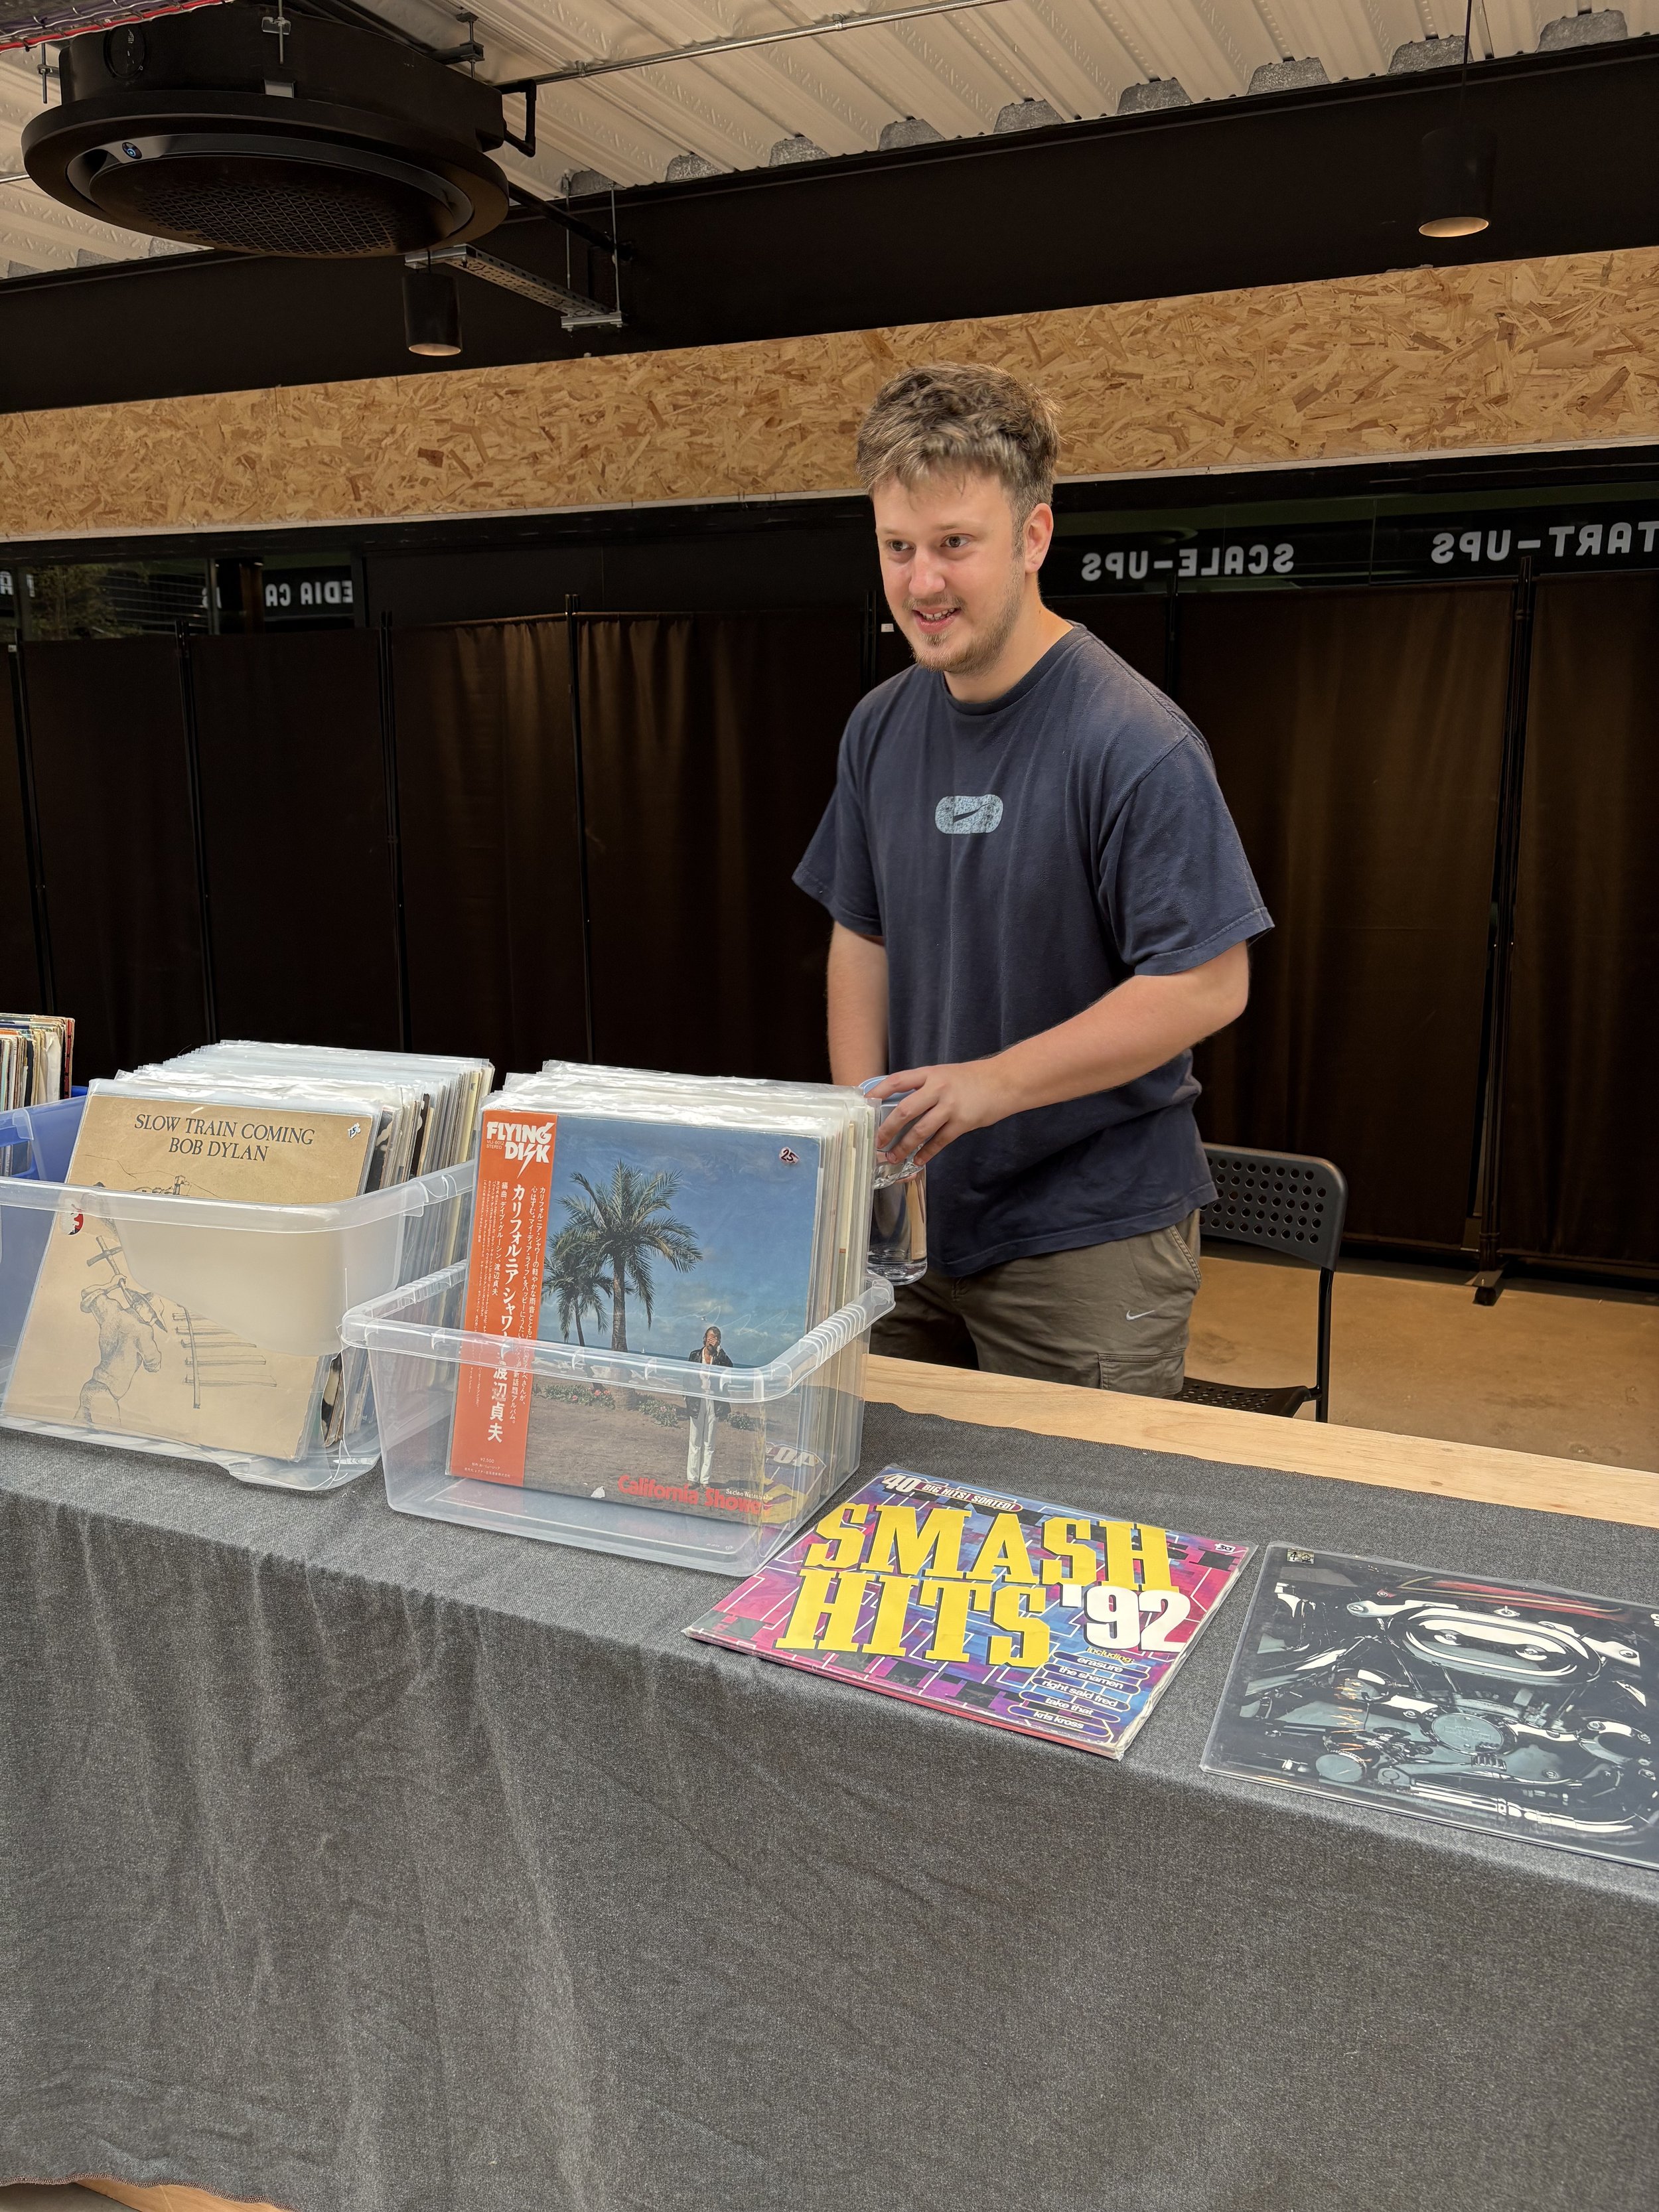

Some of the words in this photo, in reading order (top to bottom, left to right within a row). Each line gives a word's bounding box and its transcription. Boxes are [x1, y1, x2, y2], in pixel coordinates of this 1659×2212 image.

[135, 1114, 180, 1132] SLOW
[185, 1118, 238, 1138] TRAIN
[241, 1124, 315, 1145] COMING
[487, 1122, 555, 1144] FLYING
[169, 1138, 202, 1155] BOB
[207, 1141, 269, 1161] DYLAN
[781, 1149, 798, 1161] 25
[618, 1474, 699, 1505] California
[881, 1474, 922, 1493] 40
[922, 1483, 942, 1493] BIG
[942, 1487, 971, 1501] HITS!
[972, 1495, 1016, 1511] SORTED!
[805, 1503, 1180, 1593] SMASH
[775, 1568, 1051, 1668] HITS
[1061, 1583, 1192, 1653] '92
[1077, 1657, 1123, 1672] erasure
[1087, 1647, 1135, 1663] including:
[1059, 1666, 1077, 1677] the
[1078, 1672, 1124, 1689] shamen
[1042, 1680, 1068, 1693] right
[1068, 1686, 1094, 1699] said
[1094, 1695, 1119, 1708] fred
[1045, 1697, 1070, 1709] take
[1070, 1703, 1094, 1716] that
[1033, 1711, 1054, 1722] kris
[1054, 1714, 1084, 1730] kross
